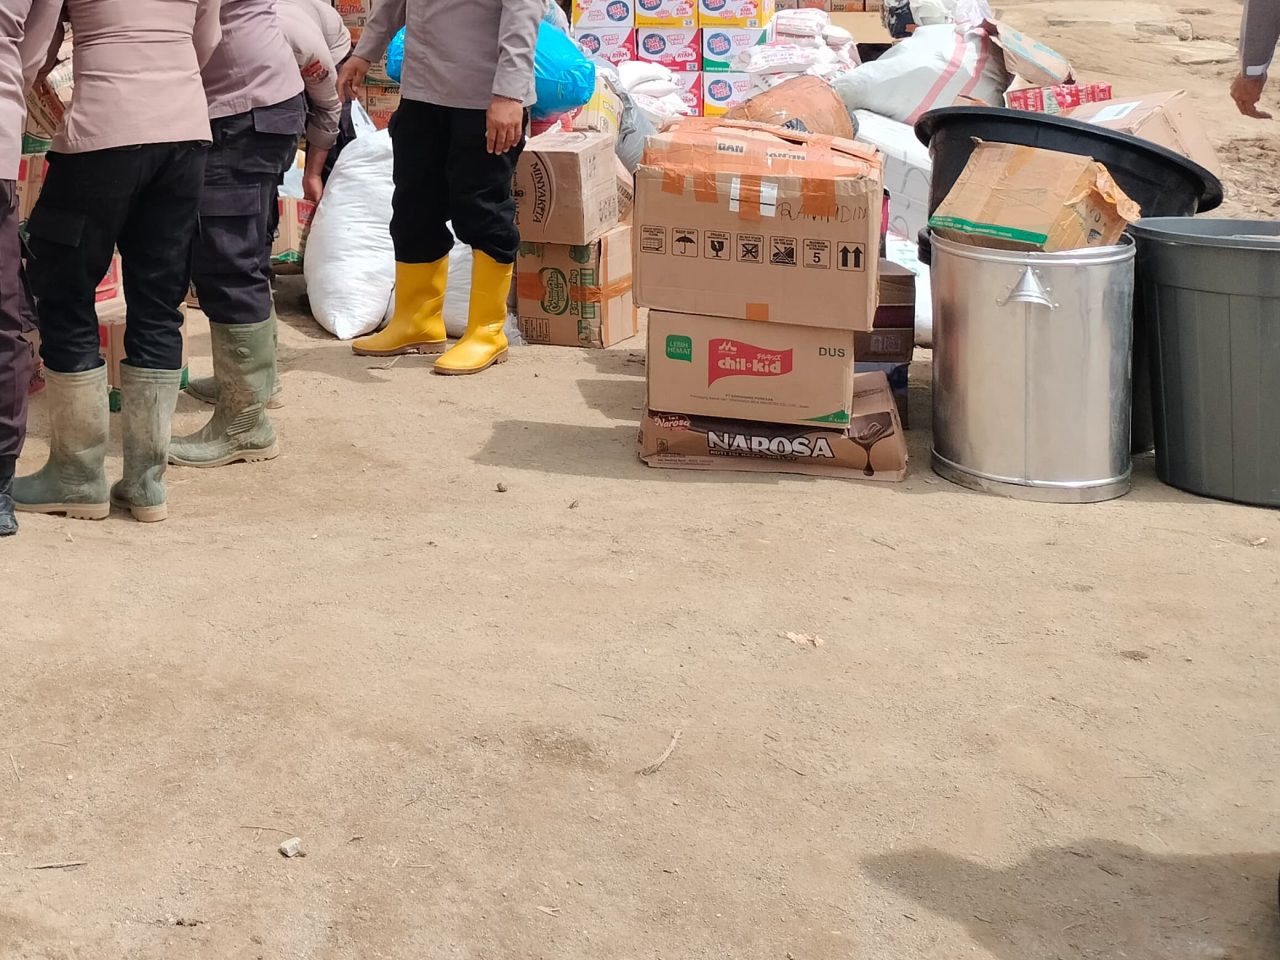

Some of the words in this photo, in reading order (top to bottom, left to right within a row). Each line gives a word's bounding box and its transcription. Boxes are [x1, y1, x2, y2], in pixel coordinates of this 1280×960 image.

[812, 252, 820, 264] 5
[668, 347, 691, 355] HEMAT
[818, 346, 845, 358] DUS
[707, 431, 835, 458] NAROSA
